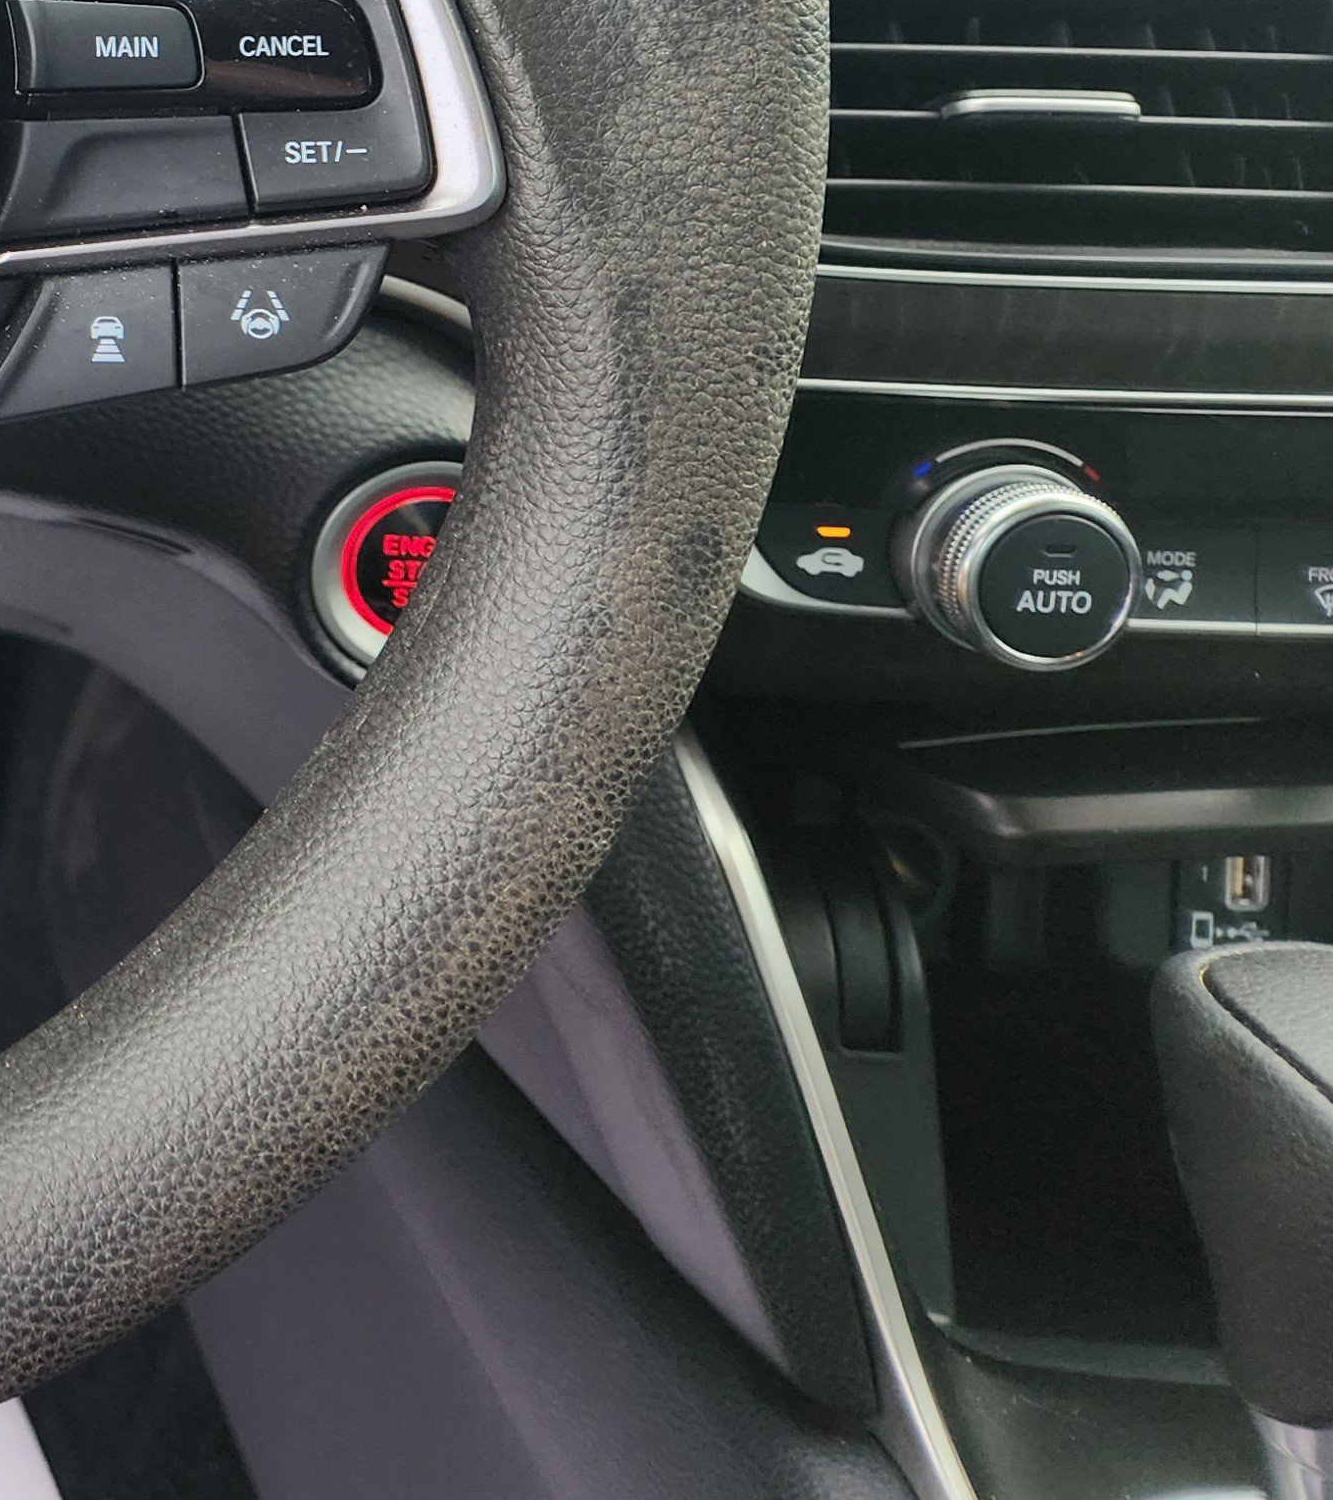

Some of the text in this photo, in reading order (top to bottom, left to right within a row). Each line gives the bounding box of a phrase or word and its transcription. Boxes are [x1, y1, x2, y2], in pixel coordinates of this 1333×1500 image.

[95, 36, 159, 58] MAIN
[239, 34, 329, 57] CANCEL
[1147, 551, 1196, 568] MODE
[1033, 568, 1081, 587] PUSH
[1016, 590, 1093, 614] AUTO
